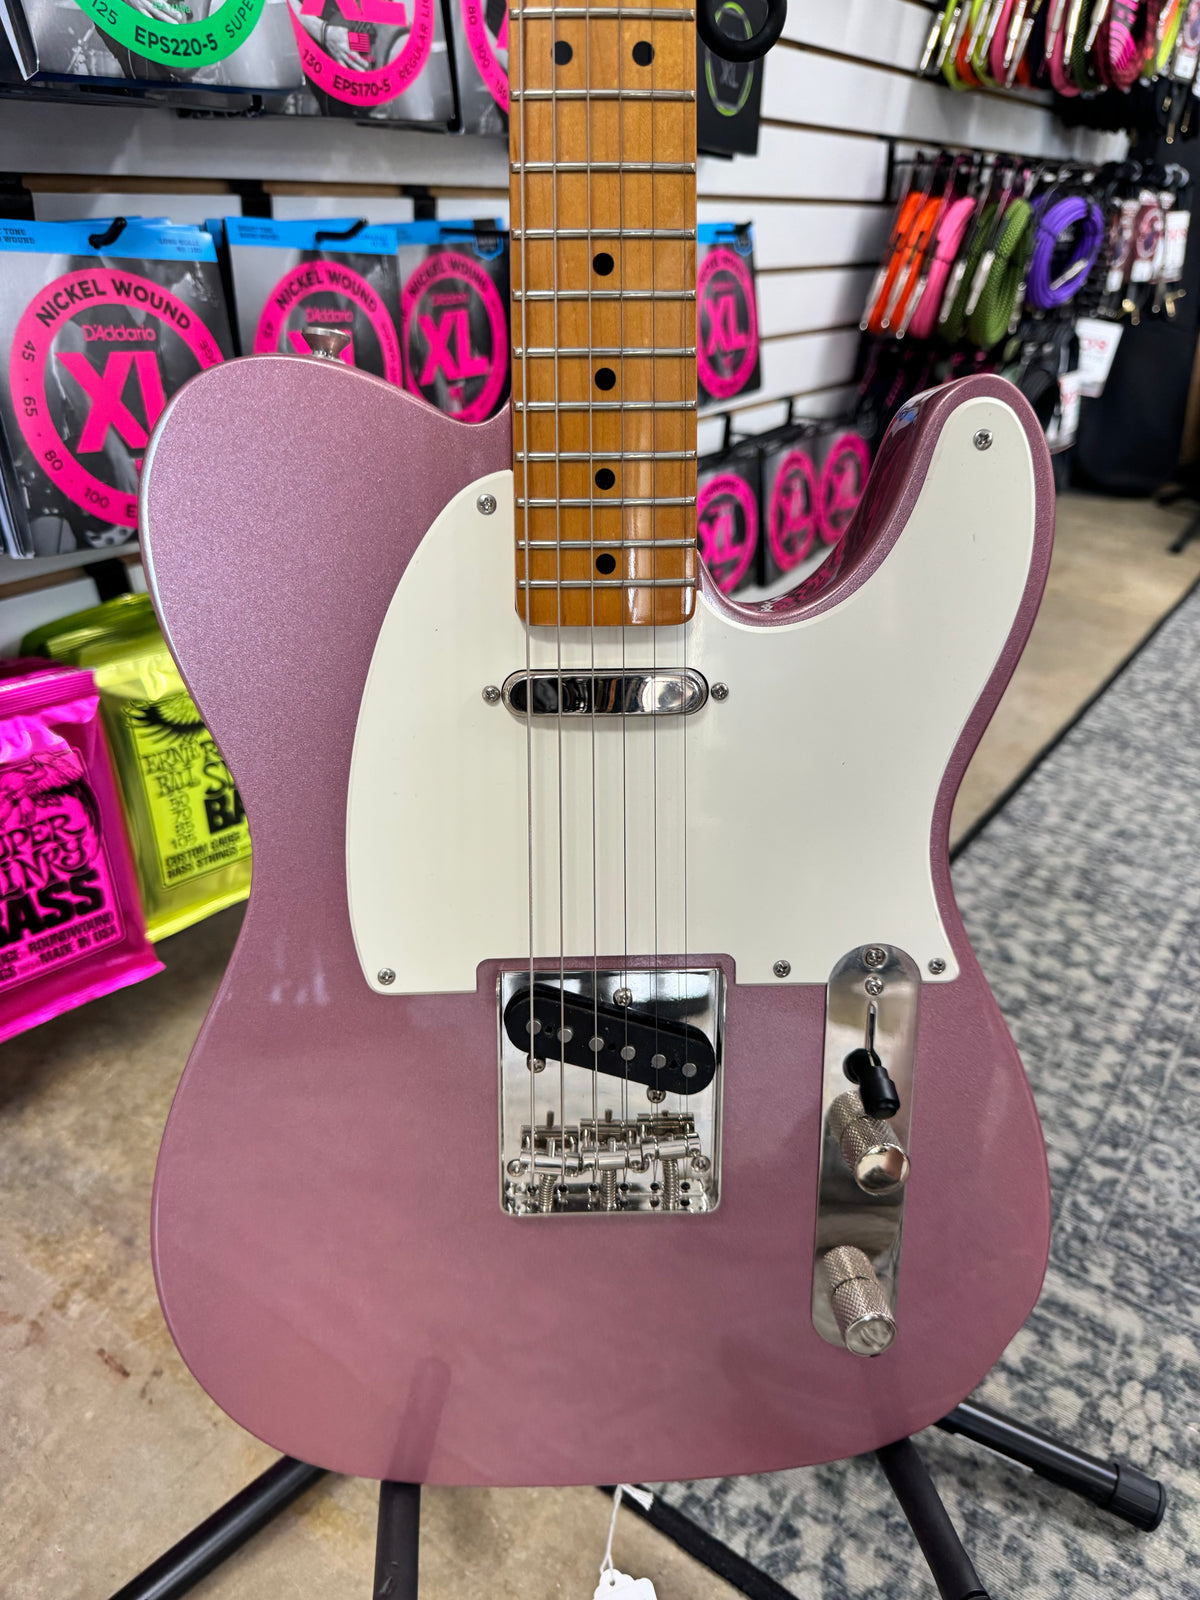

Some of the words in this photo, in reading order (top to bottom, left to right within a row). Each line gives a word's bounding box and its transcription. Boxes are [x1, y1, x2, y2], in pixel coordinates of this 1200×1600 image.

[134, 25, 218, 56] EPS220-5
[399, 23, 429, 80] REGULAR
[302, 49, 322, 74] 130
[333, 75, 391, 97] EPS170-5
[36, 278, 107, 328] NICKEL
[111, 278, 191, 330] WOUND
[276, 269, 324, 311] NICKEL
[328, 269, 378, 313] WOUND
[82, 324, 156, 342] D'Addario
[704, 294, 748, 357] XL
[22, 340, 36, 363] 45
[418, 310, 489, 387] XL
[23, 396, 38, 417] 65
[44, 450, 64, 471] 80
[84, 487, 110, 509] 100
[142, 740, 201, 775] ERNIE
[156, 767, 202, 798] BALL
[165, 844, 209, 868] CUSTOM
[0, 869, 106, 950] ASS
[28, 911, 115, 955] ROUNDWOUND
[39, 942, 73, 965] MADE
[78, 936, 91, 949] IN
[94, 923, 118, 942] USA
